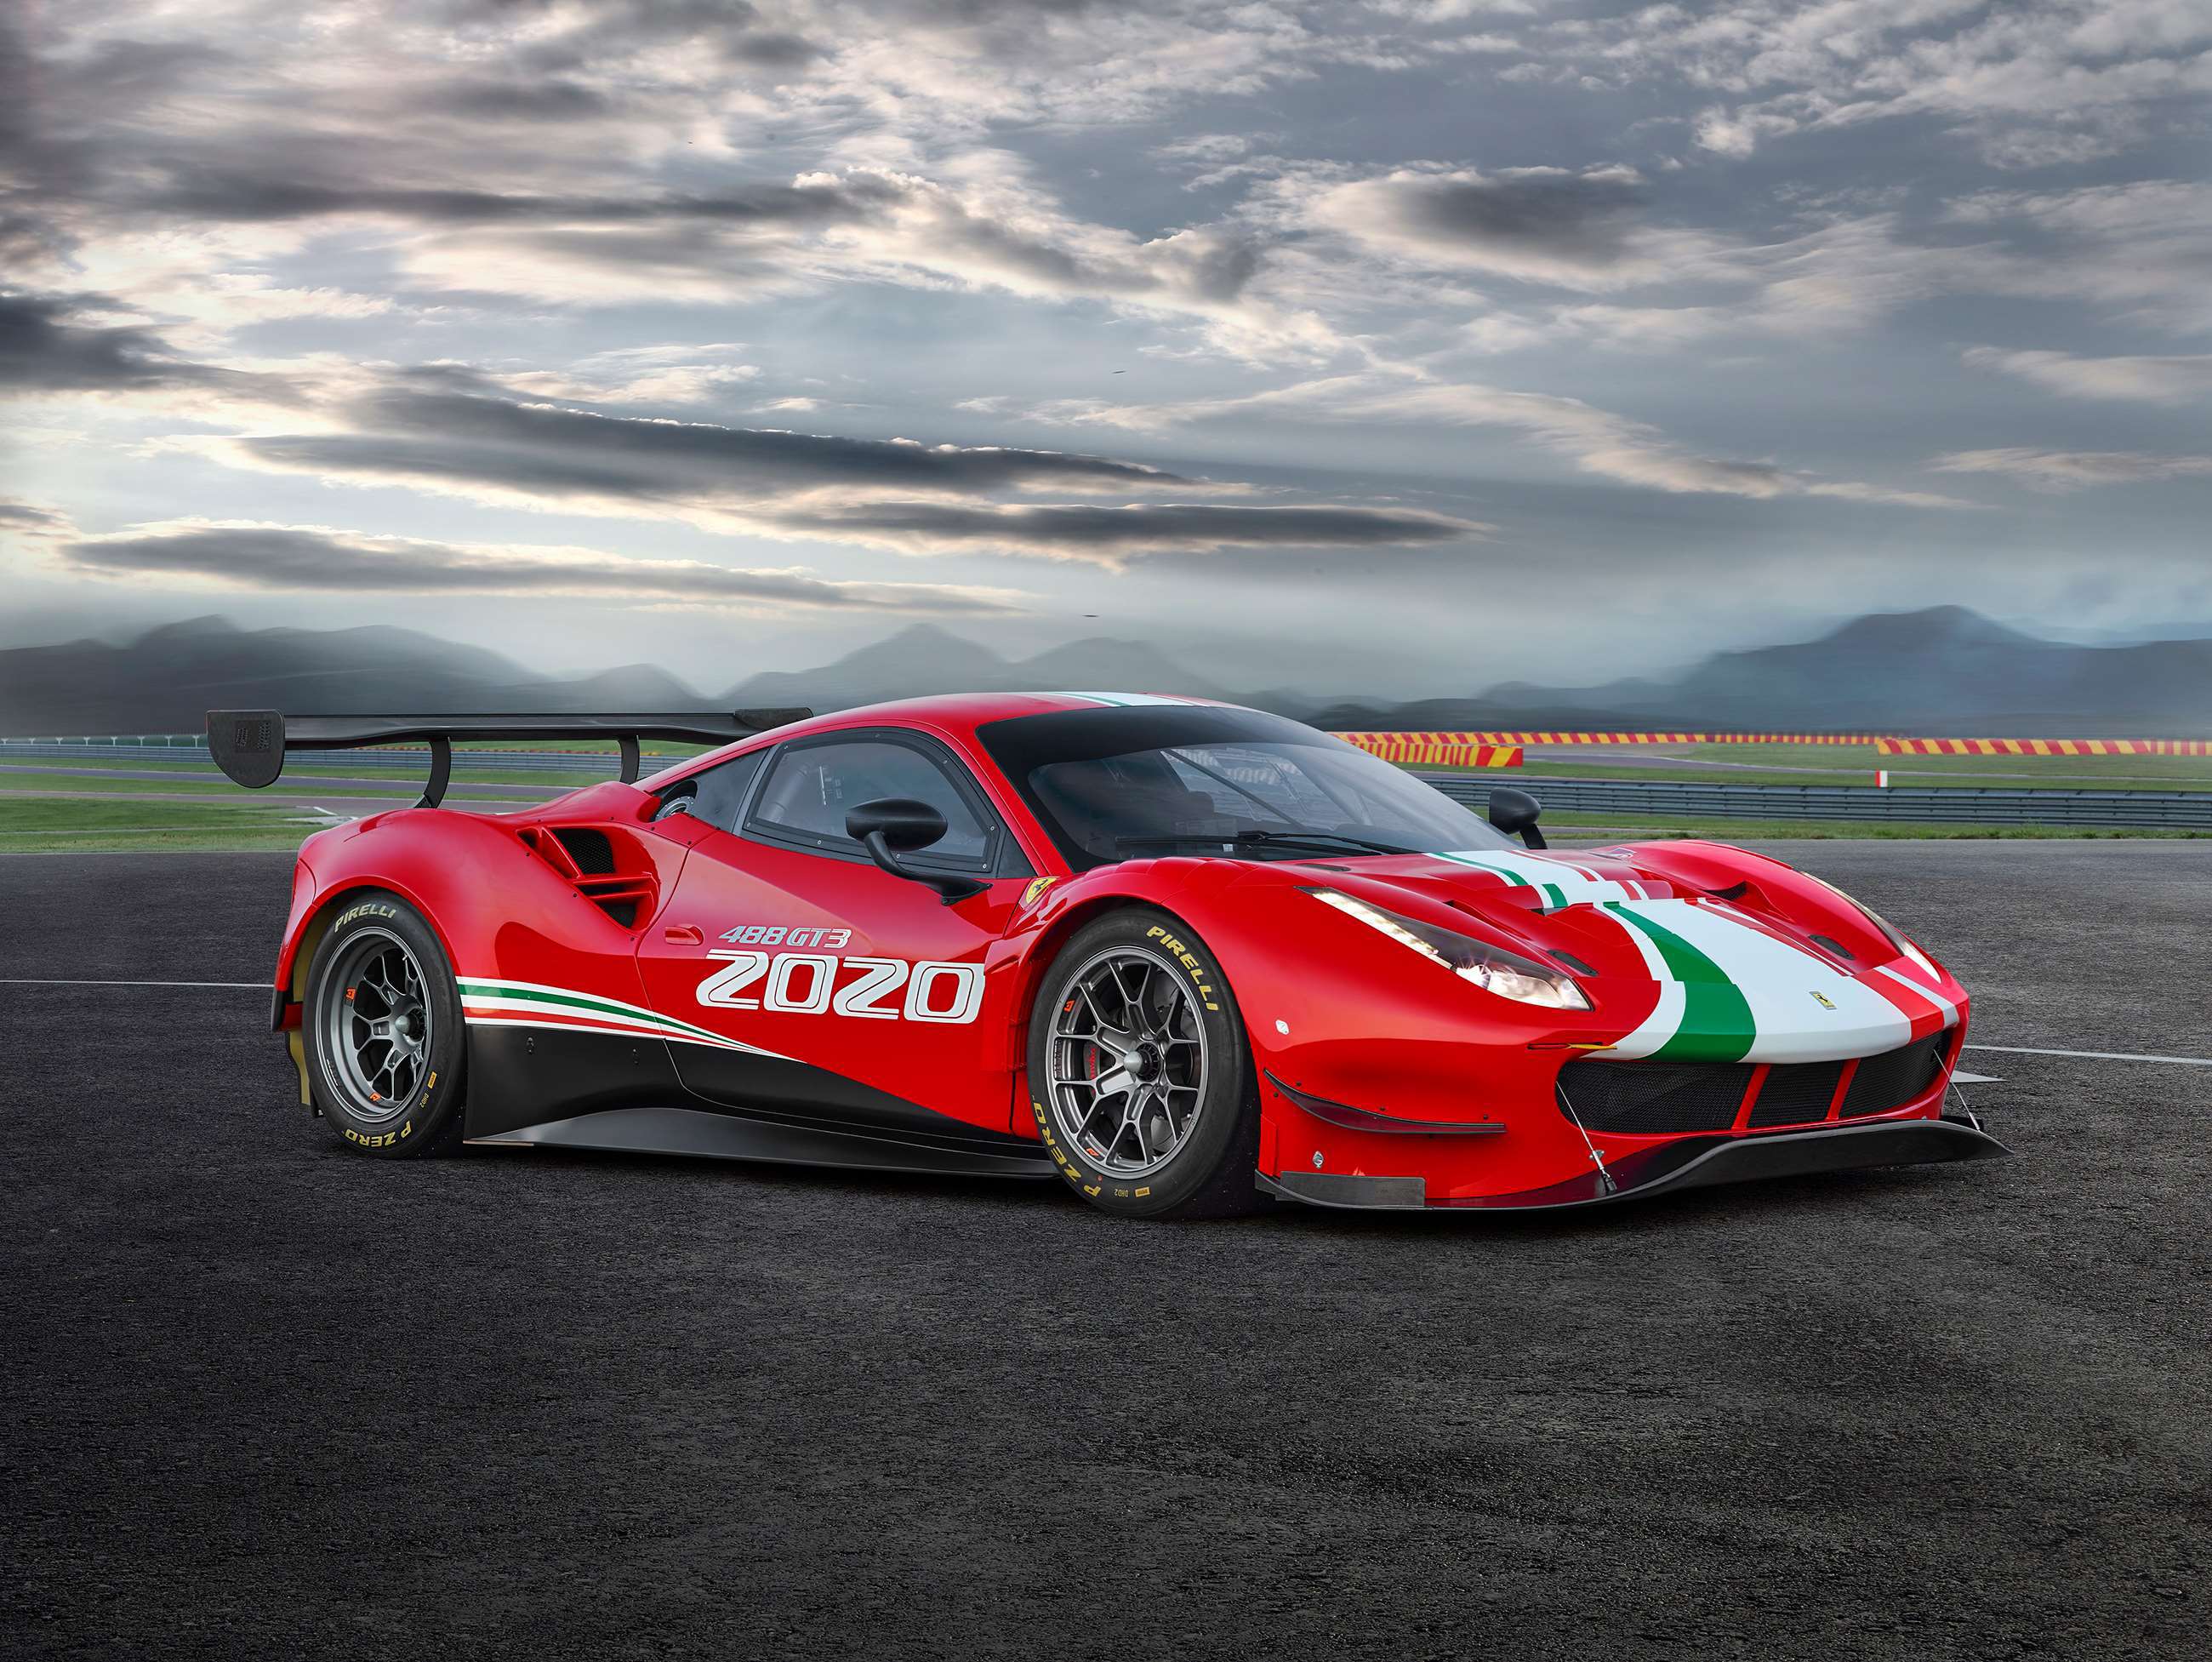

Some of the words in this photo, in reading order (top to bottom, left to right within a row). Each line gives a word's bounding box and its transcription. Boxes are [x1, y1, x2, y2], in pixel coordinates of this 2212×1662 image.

[334, 904, 396, 933] PIRELLI
[718, 925, 789, 946] 488
[785, 928, 852, 949] GT3
[1147, 925, 1219, 1012] PIRELLI
[695, 949, 985, 1025] 2020
[345, 1128, 396, 1147] ZERO
[400, 1120, 413, 1137] P
[1033, 1102, 1083, 1182] ZERO
[1083, 1184, 1102, 1197] P
